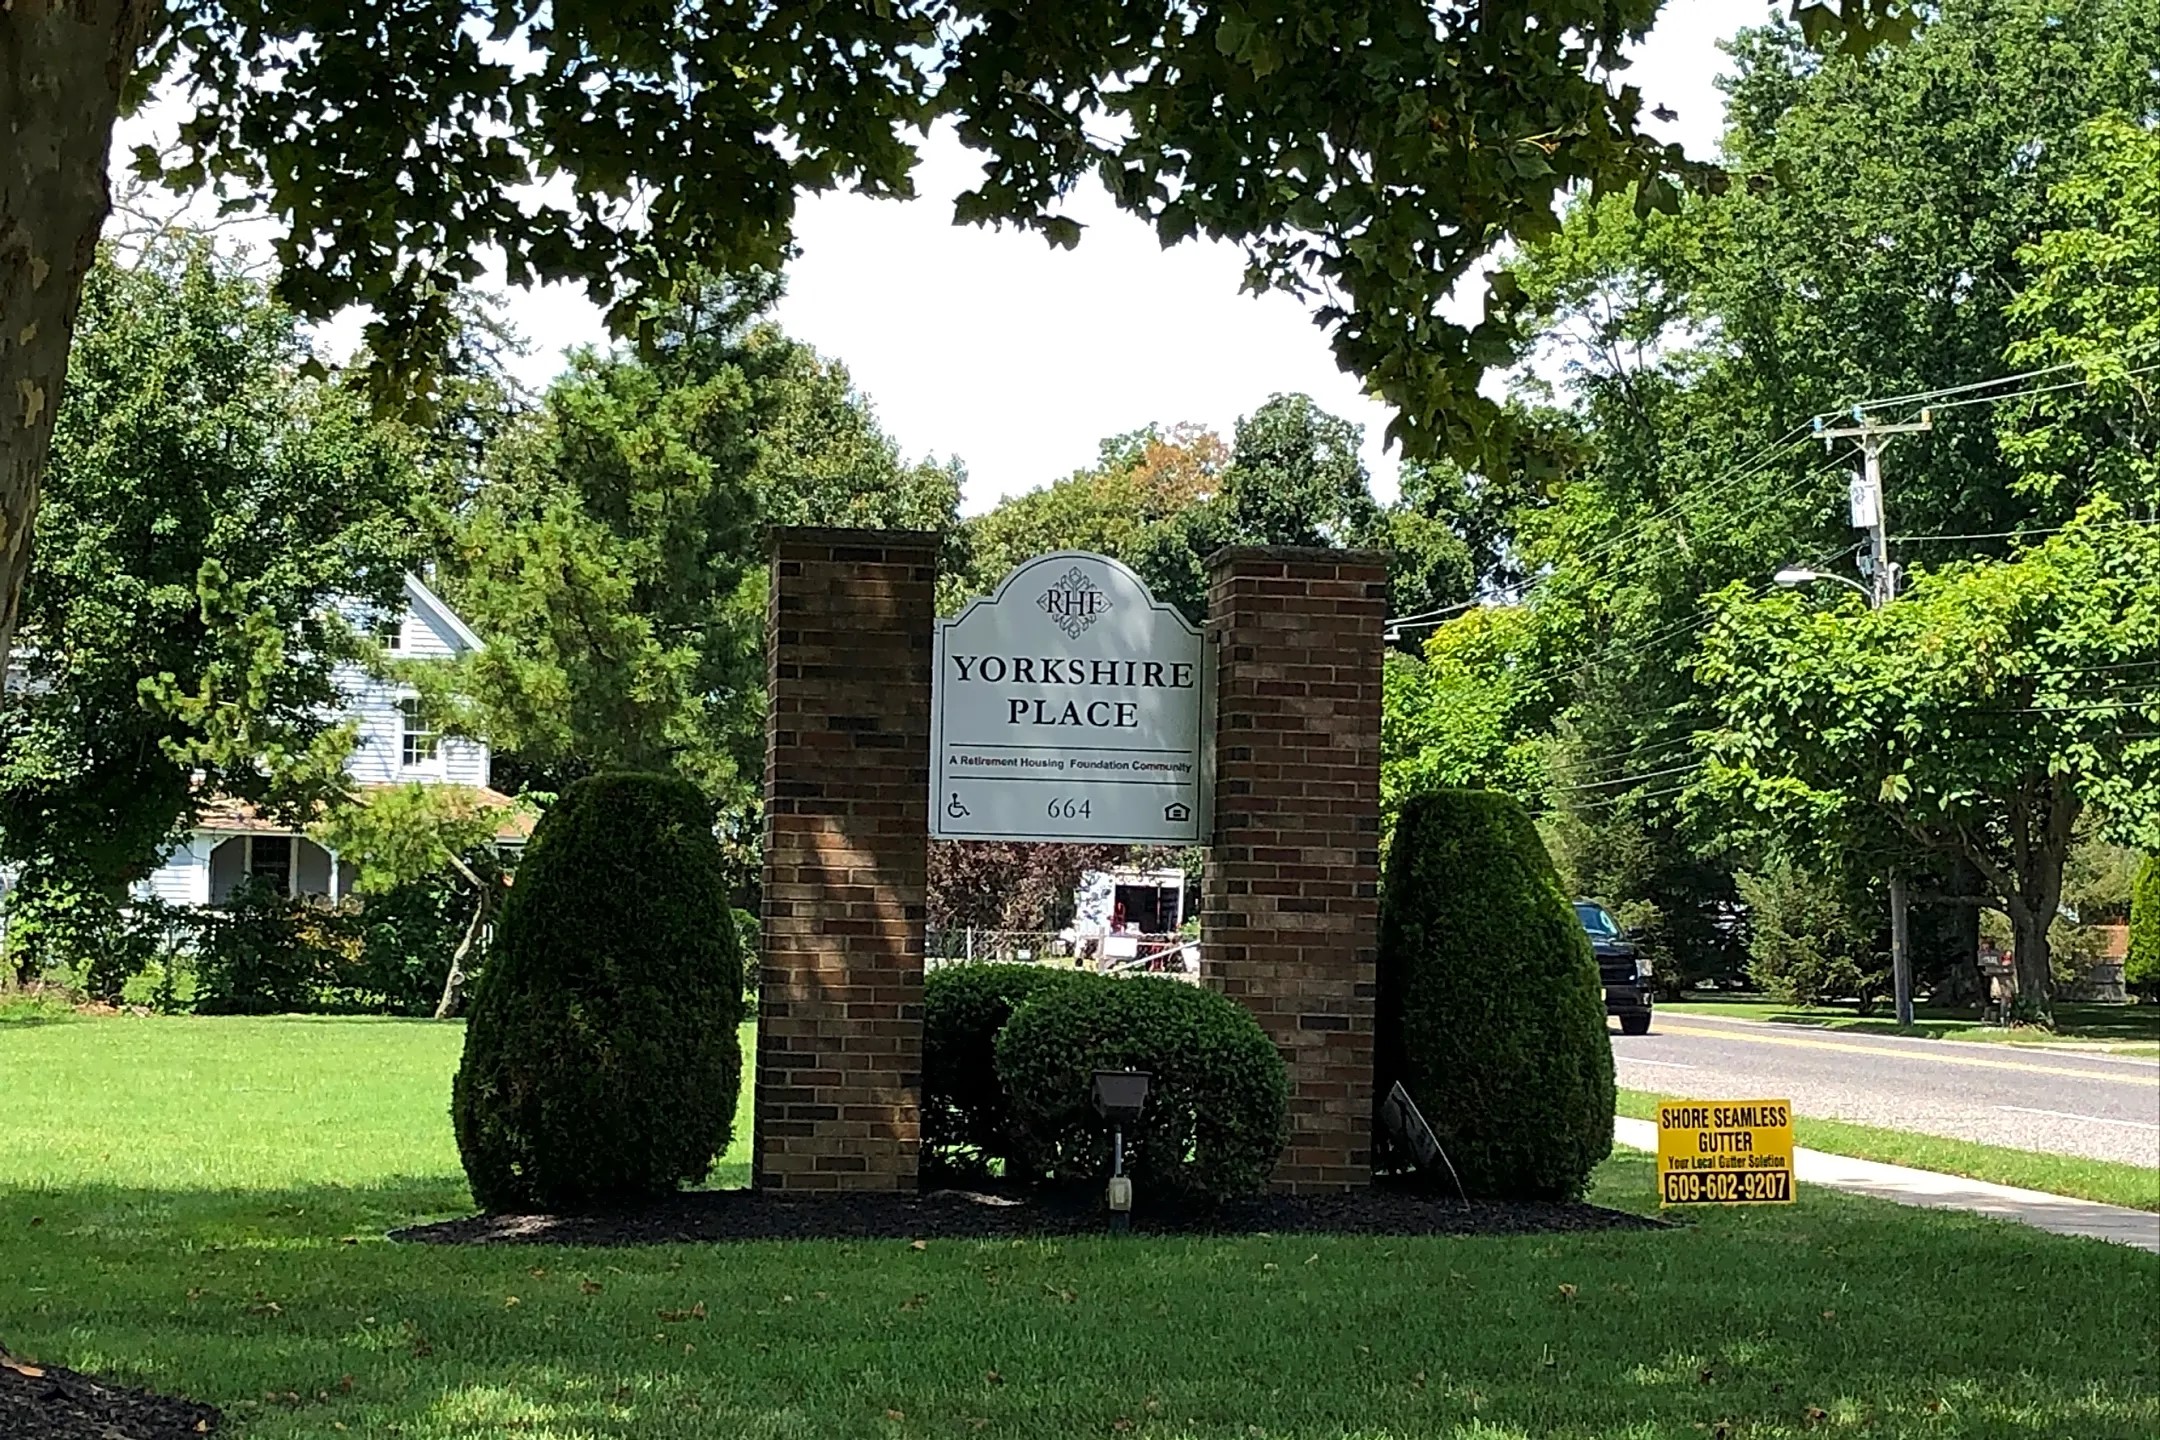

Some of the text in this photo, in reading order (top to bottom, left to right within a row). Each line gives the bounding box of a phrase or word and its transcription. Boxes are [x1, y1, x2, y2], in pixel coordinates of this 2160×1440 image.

[952, 655, 1194, 688] YORKSHIRE
[1007, 698, 1138, 728] PLACE
[949, 755, 1192, 773] A Retirement Housing Foundation Community
[1047, 798, 1091, 819] 664
[1662, 1106, 1787, 1129] SHORE SEAMLESS
[1699, 1131, 1753, 1153] GUTTER
[1668, 1154, 1785, 1169] Your Local Gutter Solution
[1667, 1172, 1786, 1201] 609-602-9207
